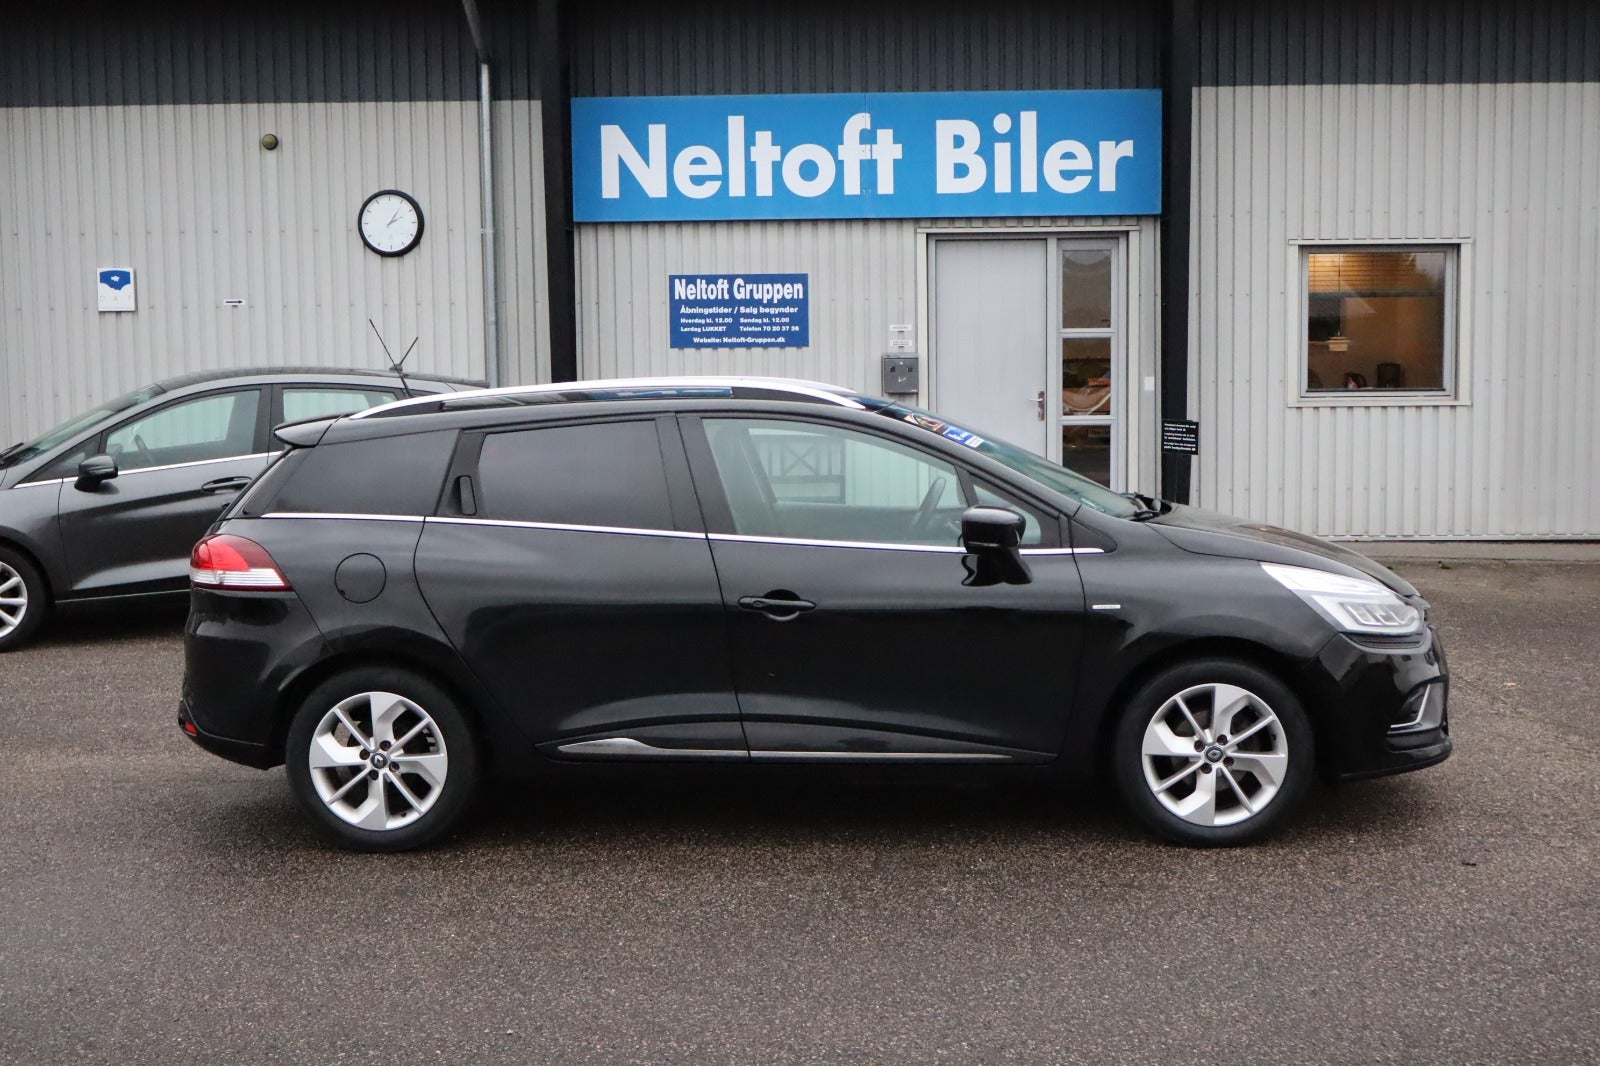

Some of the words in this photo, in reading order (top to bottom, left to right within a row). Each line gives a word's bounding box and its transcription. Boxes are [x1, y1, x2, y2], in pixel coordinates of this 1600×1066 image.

[601, 112, 903, 200] Neltoft
[936, 110, 1134, 195] Biler
[674, 278, 730, 300] Neltoft
[733, 277, 804, 304] Gruppen
[680, 305, 732, 315] Åbningstider
[733, 306, 738, 314] /
[739, 306, 758, 315] Salg
[759, 306, 798, 314] begynder
[722, 336, 786, 344] Neltoft-Gruppen.dk
